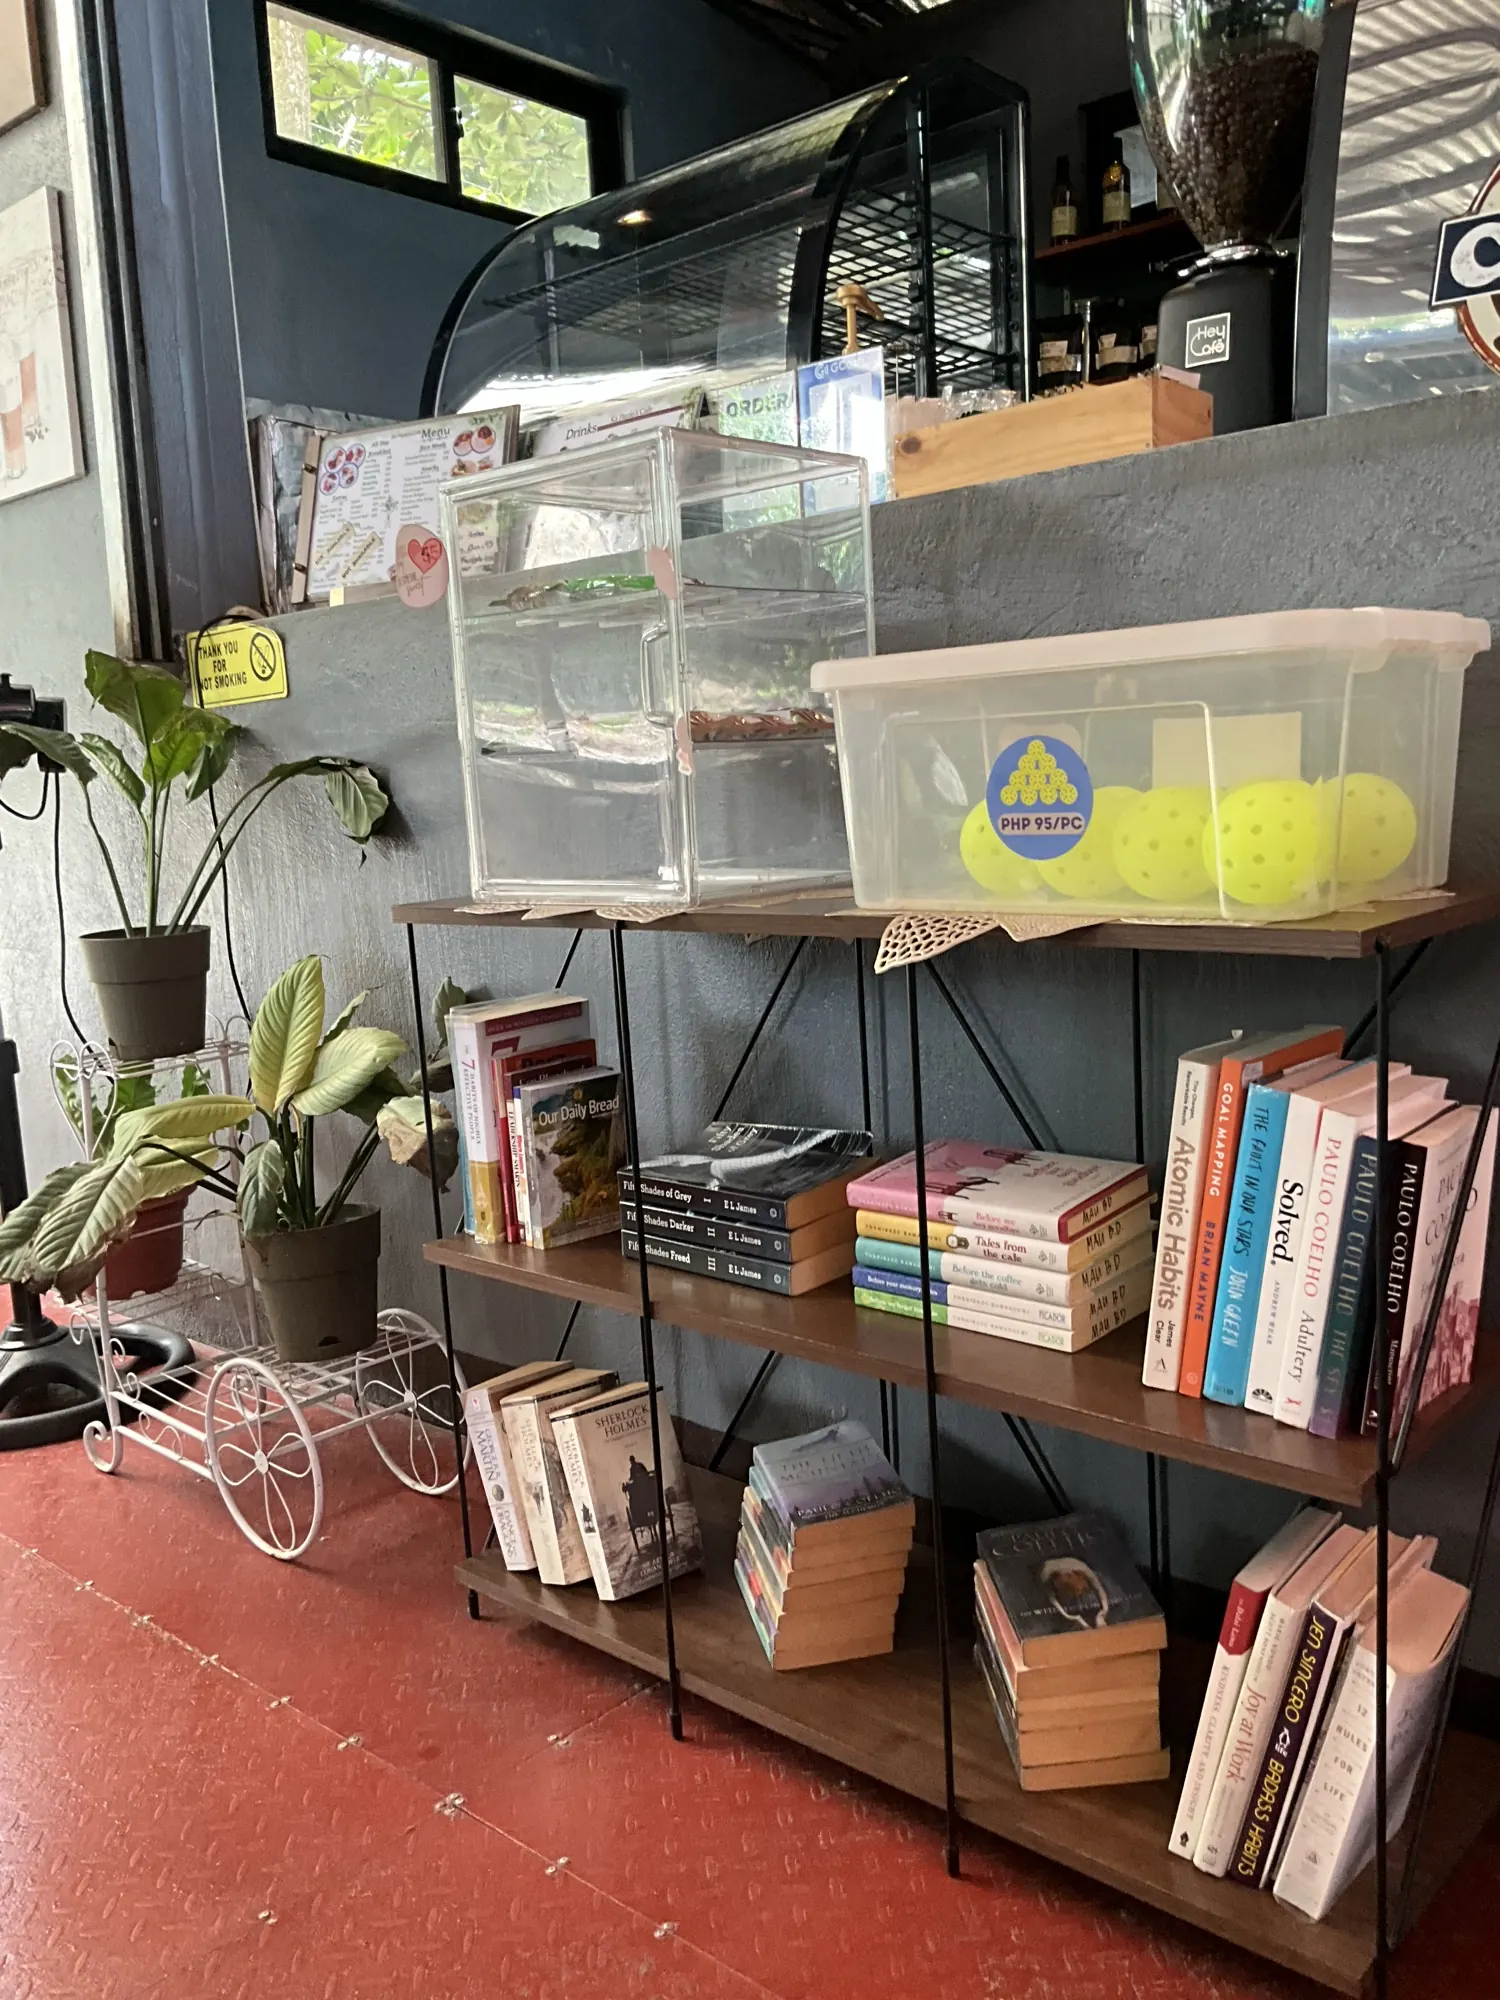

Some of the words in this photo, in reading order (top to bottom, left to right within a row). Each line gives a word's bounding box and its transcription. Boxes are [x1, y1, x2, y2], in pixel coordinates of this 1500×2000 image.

[1197, 325, 1226, 340] Hey
[726, 392, 790, 417] ORDER
[421, 427, 451, 440] Menu
[566, 423, 598, 440] Drinks
[199, 643, 222, 660] THANK
[224, 641, 238, 656] YOU
[213, 659, 227, 673] FOR
[214, 672, 247, 689] SMOKING
[1001, 817, 1031, 831] PHP
[1034, 816, 1082, 831] 95/PC
[461, 1059, 475, 1070] 7
[538, 1111, 559, 1126] Our
[561, 1104, 586, 1121] Daily
[589, 1095, 620, 1114] Bread
[1219, 1082, 1233, 1123] GOAL
[1253, 1107, 1269, 1132] THE
[1209, 1127, 1227, 1197] MAPPING
[1248, 1138, 1267, 1172] FAULT
[1166, 1136, 1195, 1228] Atomic
[1244, 1174, 1260, 1191] IN
[1318, 1136, 1342, 1205] PAULO
[623, 1181, 635, 1191] Fift
[640, 1183, 665, 1197] Shades
[666, 1188, 674, 1198] of
[674, 1190, 692, 1204] Grey
[1351, 1153, 1378, 1224] PAULO
[1396, 1163, 1418, 1227] PAULO
[724, 1200, 729, 1209] E
[730, 1201, 735, 1210] L
[735, 1202, 757, 1214] James
[1239, 1192, 1257, 1215] OUR
[643, 1214, 669, 1228] Shades
[669, 1219, 695, 1232] Darker
[1270, 1179, 1304, 1266] Solved.
[728, 1231, 733, 1240] E
[734, 1232, 739, 1241] L
[740, 1233, 762, 1246] James
[975, 1235, 1001, 1249] Tales
[1004, 1240, 1027, 1253] from
[1201, 1221, 1216, 1266] BRIAN
[1233, 1218, 1252, 1257] STARS
[645, 1244, 670, 1258] Shades
[670, 1250, 691, 1264] Freed
[983, 1249, 998, 1258] the
[1303, 1211, 1329, 1297] COELHO
[728, 1264, 734, 1274] E
[734, 1265, 740, 1275] L
[740, 1266, 762, 1280] James
[867, 1275, 885, 1285] Before
[886, 1280, 898, 1289] your
[952, 1264, 980, 1276] Before
[981, 1270, 995, 1280] the
[997, 1274, 1022, 1285] coffee
[1157, 1233, 1187, 1311] Habits
[1227, 1265, 1248, 1301] JOHN
[1335, 1231, 1366, 1316] COELHO
[1387, 1232, 1409, 1313] COELHO
[1194, 1272, 1209, 1322] MAYNE
[1270, 1280, 1280, 1318] ANDREW
[1038, 1310, 1065, 1324] PICADOR
[1221, 1303, 1242, 1349] GREEN
[1038, 1332, 1065, 1346] PICADOR
[1155, 1320, 1165, 1343] Clear
[1166, 1320, 1176, 1347] James
[1266, 1319, 1276, 1345] WEAR
[1330, 1329, 1347, 1361] THE
[1288, 1310, 1314, 1383] Adultery
[595, 1404, 650, 1429] SHERLOCK
[604, 1416, 647, 1437] HOLMES
[476, 1430, 498, 1481] MARTIN
[564, 1441, 578, 1484] HOLMES
[569, 1432, 585, 1488] SHERLOCK
[798, 1504, 840, 1516] PAULO
[842, 1487, 900, 1506] COELHO
[495, 1506, 513, 1558] DRAGONS
[1233, 1606, 1245, 1626] Dalai
[1307, 1616, 1325, 1650] JEN
[1285, 1649, 1317, 1723] SINCERO
[1241, 1684, 1267, 1717] Joy
[1357, 1703, 1368, 1717] 12
[1203, 1716, 1218, 1757] CLARITY
[1239, 1718, 1254, 1738] at
[1336, 1724, 1368, 1752] RULES
[1195, 1761, 1207, 1780] AND
[1226, 1740, 1254, 1784] Work
[1333, 1755, 1353, 1775] FOR
[1186, 1783, 1202, 1821] INSIGHT
[1255, 1758, 1285, 1822] BADASS
[1323, 1782, 1346, 1801] LIFE
[1238, 1822, 1265, 1876] HABITS
